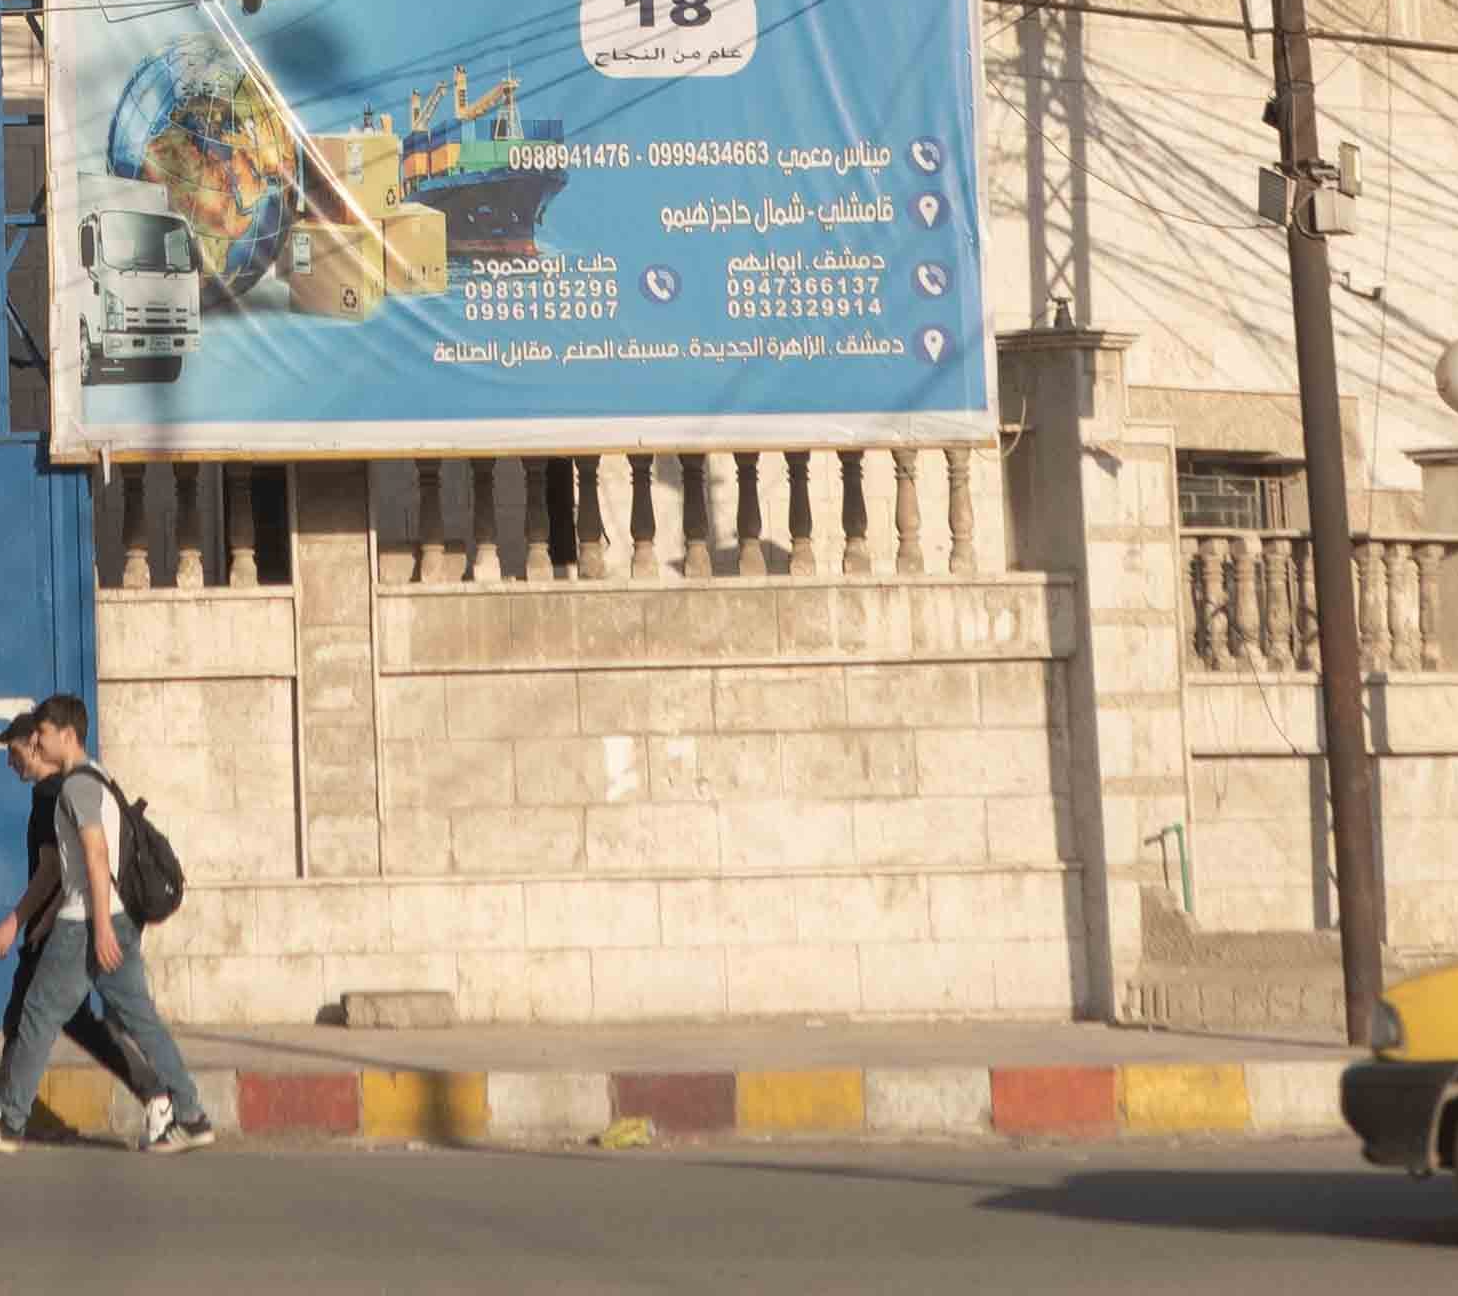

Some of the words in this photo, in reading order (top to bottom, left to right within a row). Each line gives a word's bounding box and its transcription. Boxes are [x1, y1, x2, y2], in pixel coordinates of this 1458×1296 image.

[594, 47, 665, 67] النجاح
[672, 48, 701, 64] من
[708, 47, 743, 64] عام
[647, 140, 770, 169] 0999434663
[755, 192, 805, 234] شمال
[818, 192, 895, 232] قامشلي
[578, 253, 618, 276] حلب
[813, 247, 885, 272] دمشق
[465, 279, 619, 300] 0983105296
[727, 276, 880, 296] 0947366137
[465, 301, 619, 321] 0996152007
[728, 298, 883, 319] 0932329914
[689, 335, 764, 363] الجديدة
[836, 330, 905, 357] دمشق
